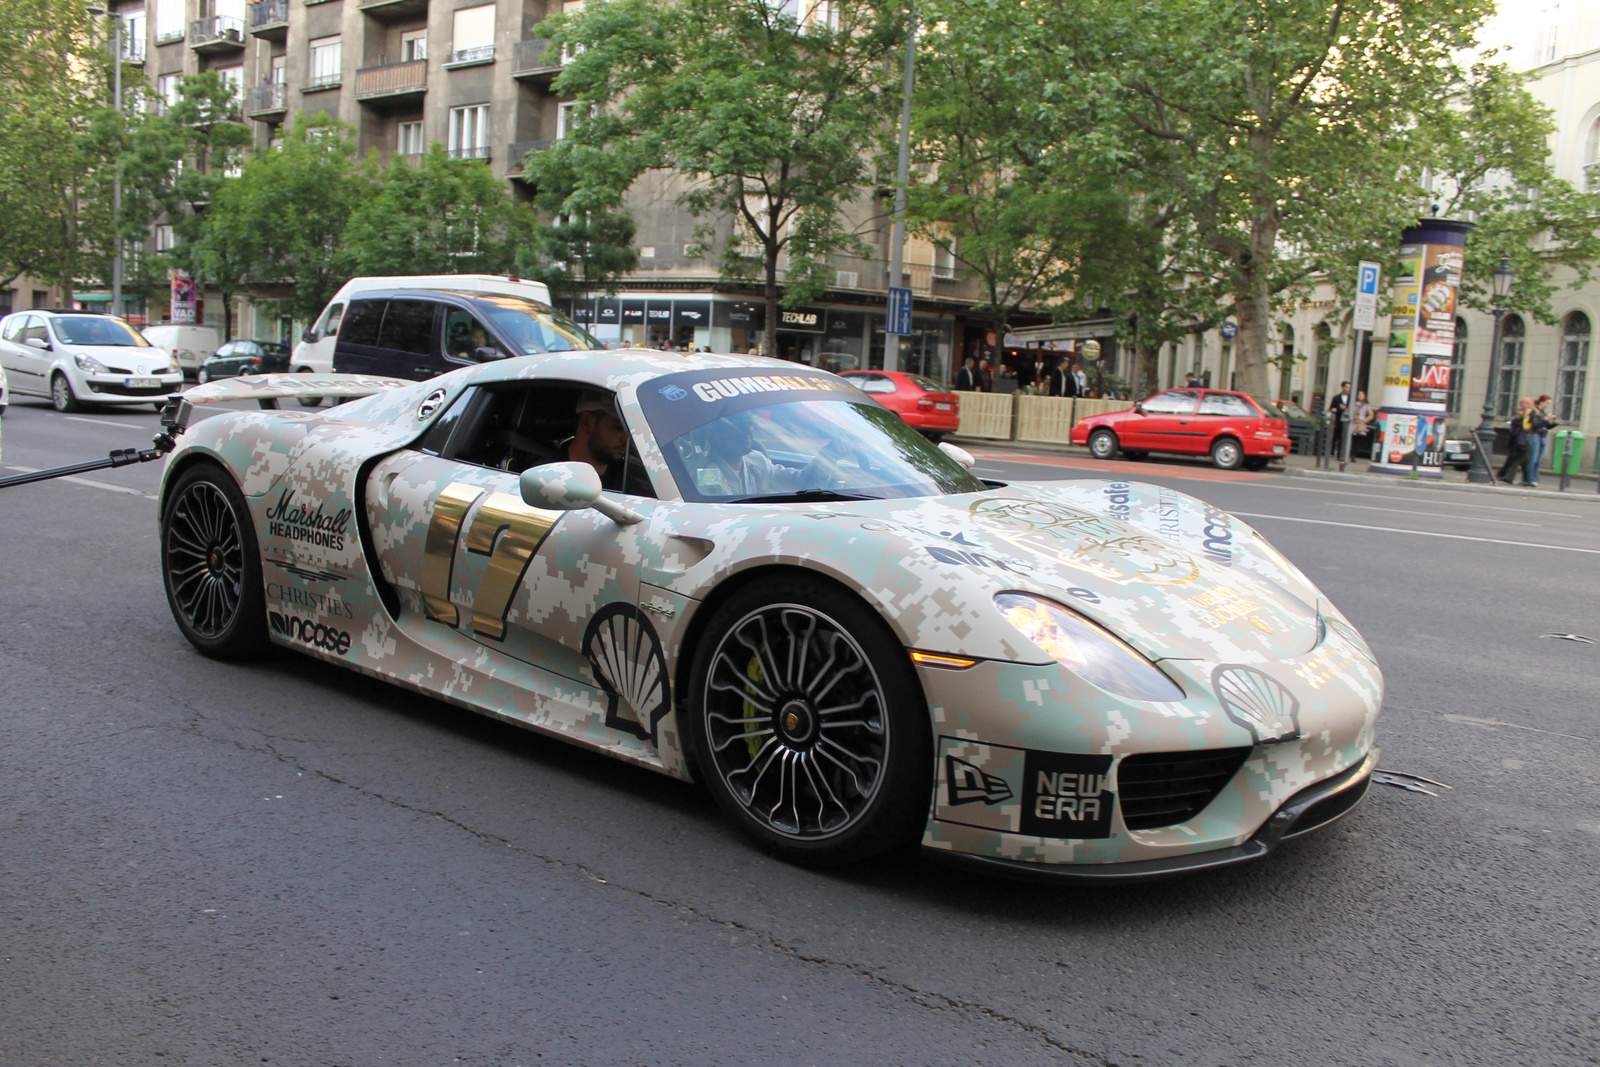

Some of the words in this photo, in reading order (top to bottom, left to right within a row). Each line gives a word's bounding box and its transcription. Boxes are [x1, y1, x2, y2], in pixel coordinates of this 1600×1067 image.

[1362, 270, 1374, 290] P
[782, 311, 817, 325] TECHLAB
[692, 375, 818, 402] GUMBALL
[266, 488, 352, 535] Marshall
[270, 521, 344, 551] HEADPHONES
[420, 482, 569, 643] 17
[266, 582, 353, 620] CHRISTIE'S
[283, 613, 351, 656] incase
[1036, 770, 1106, 798] NEW
[1034, 795, 1100, 822] ERA
